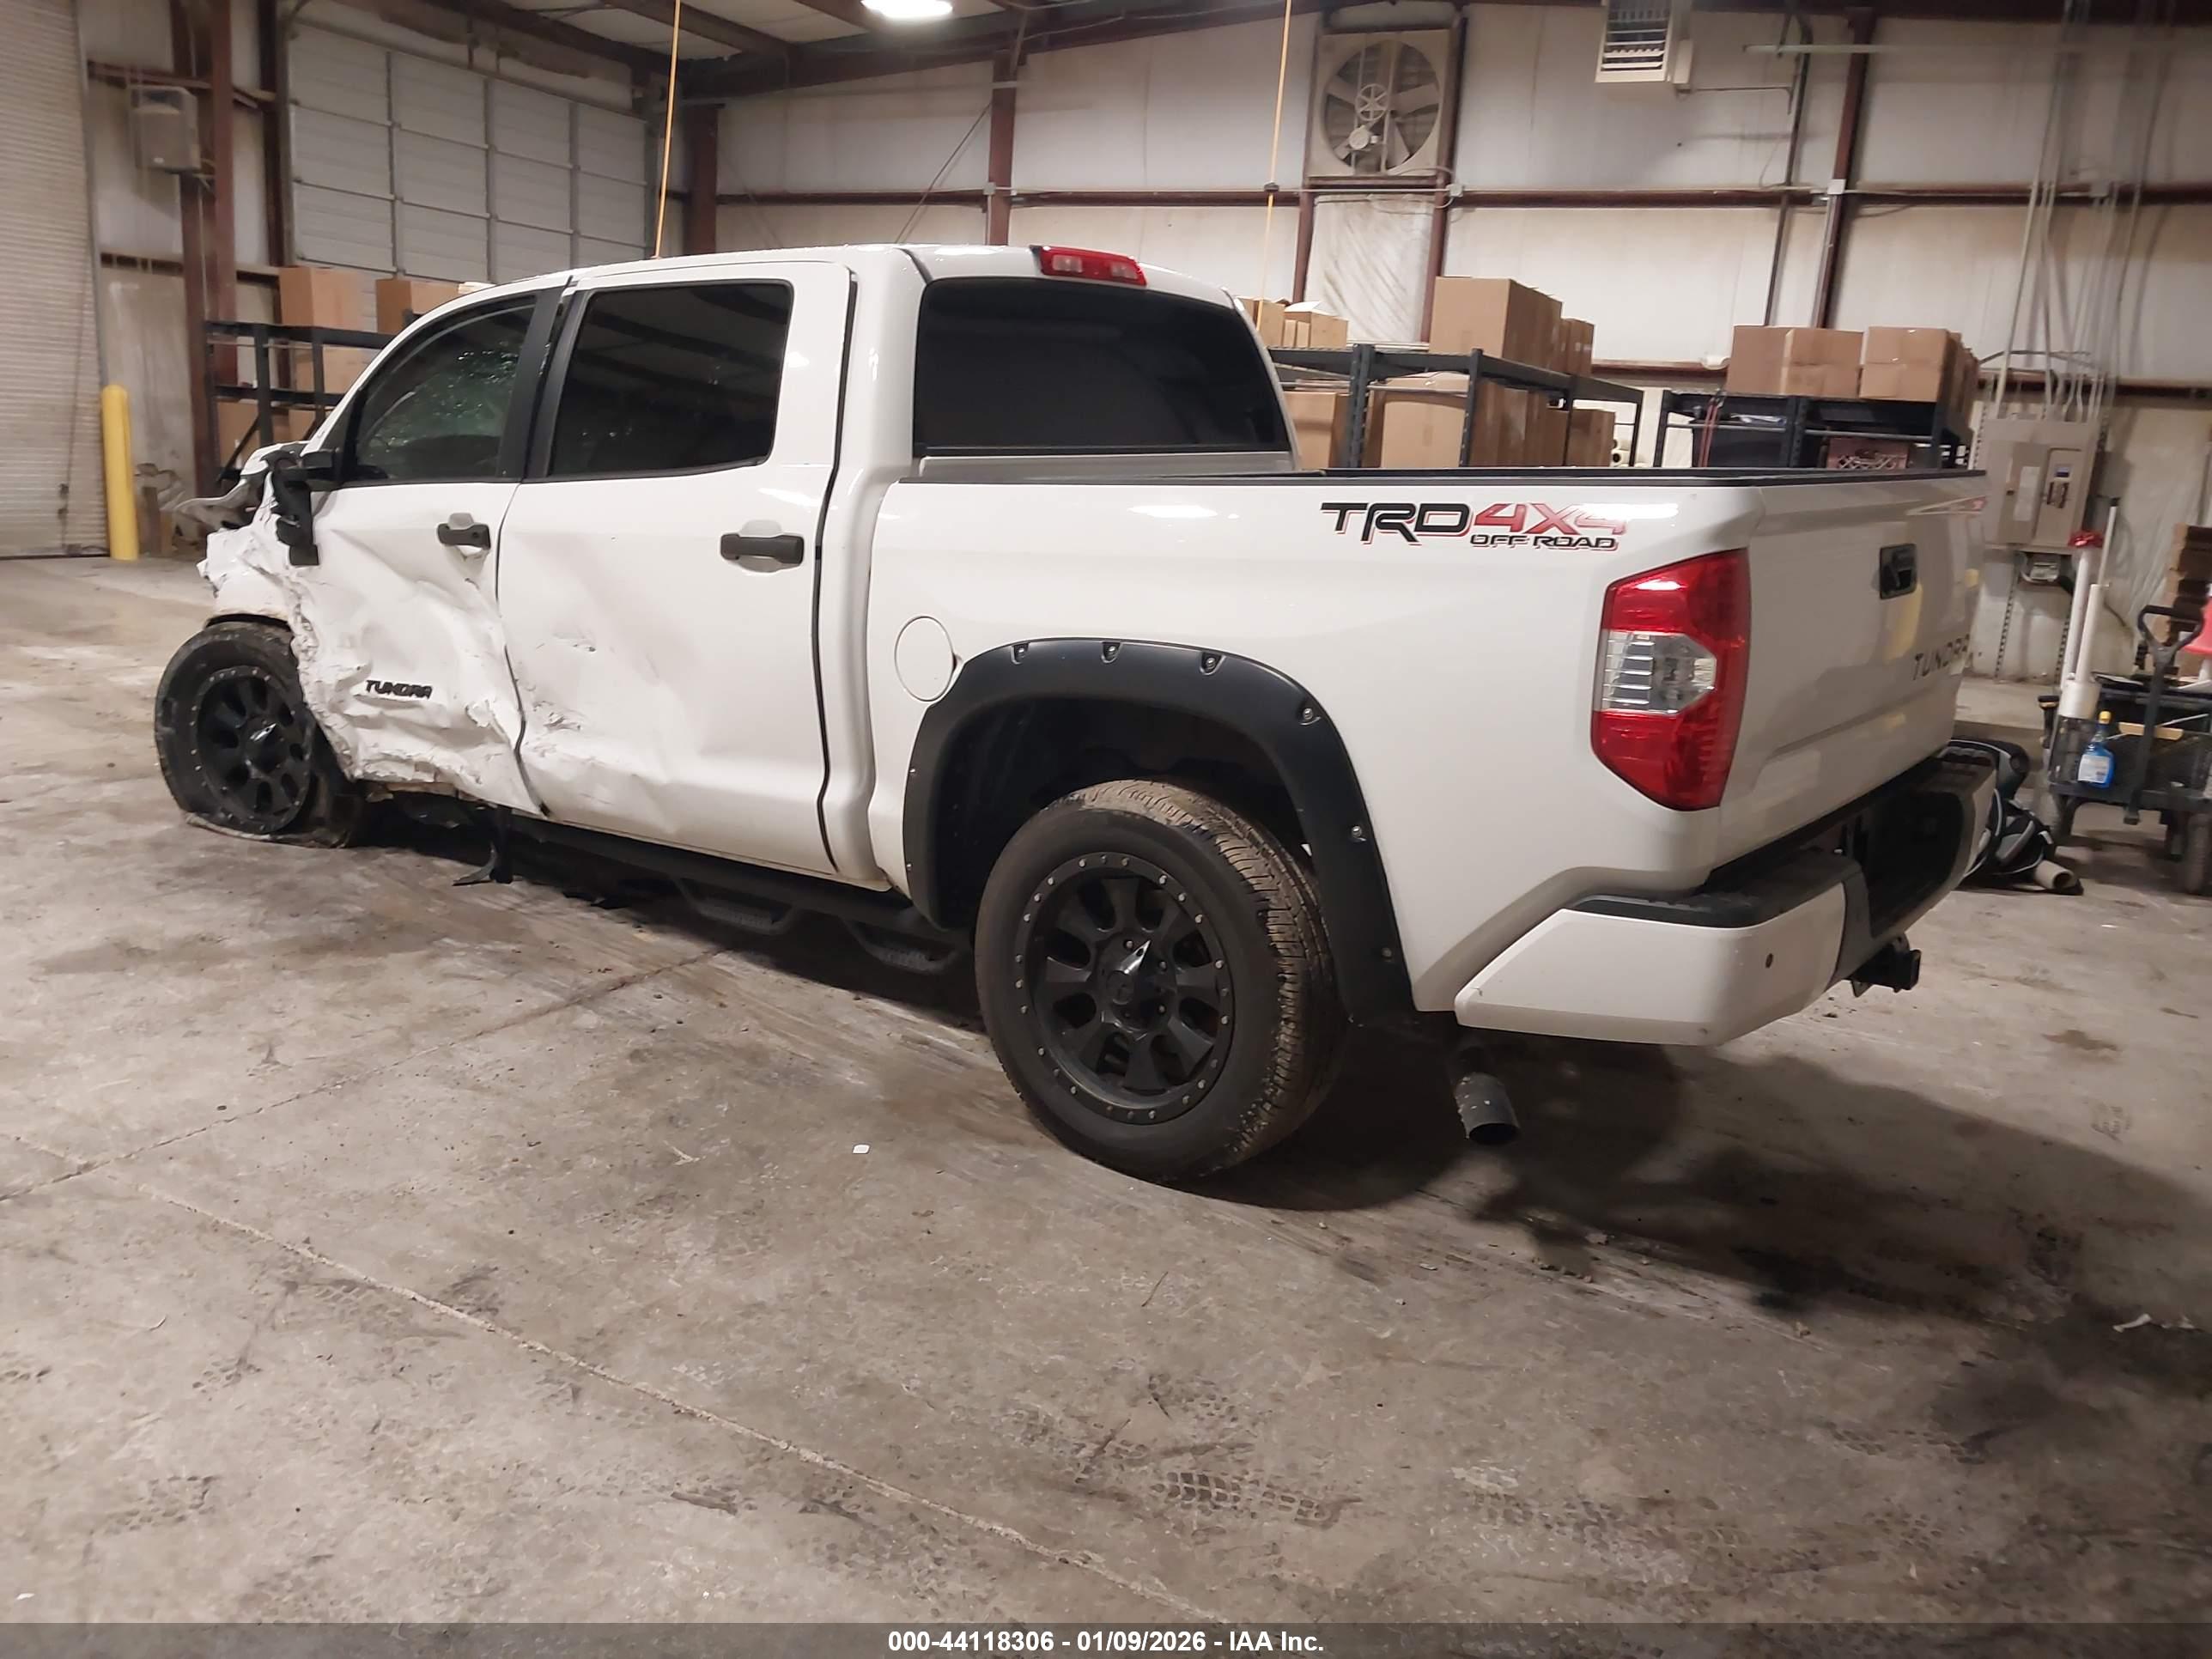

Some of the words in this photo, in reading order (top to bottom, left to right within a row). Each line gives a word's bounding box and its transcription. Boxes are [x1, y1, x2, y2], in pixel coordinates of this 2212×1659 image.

[1321, 502, 1470, 544] TRD
[1470, 535, 1528, 549] OFF
[1534, 536, 1618, 551] ROAD
[366, 679, 433, 699] TUNDRA
